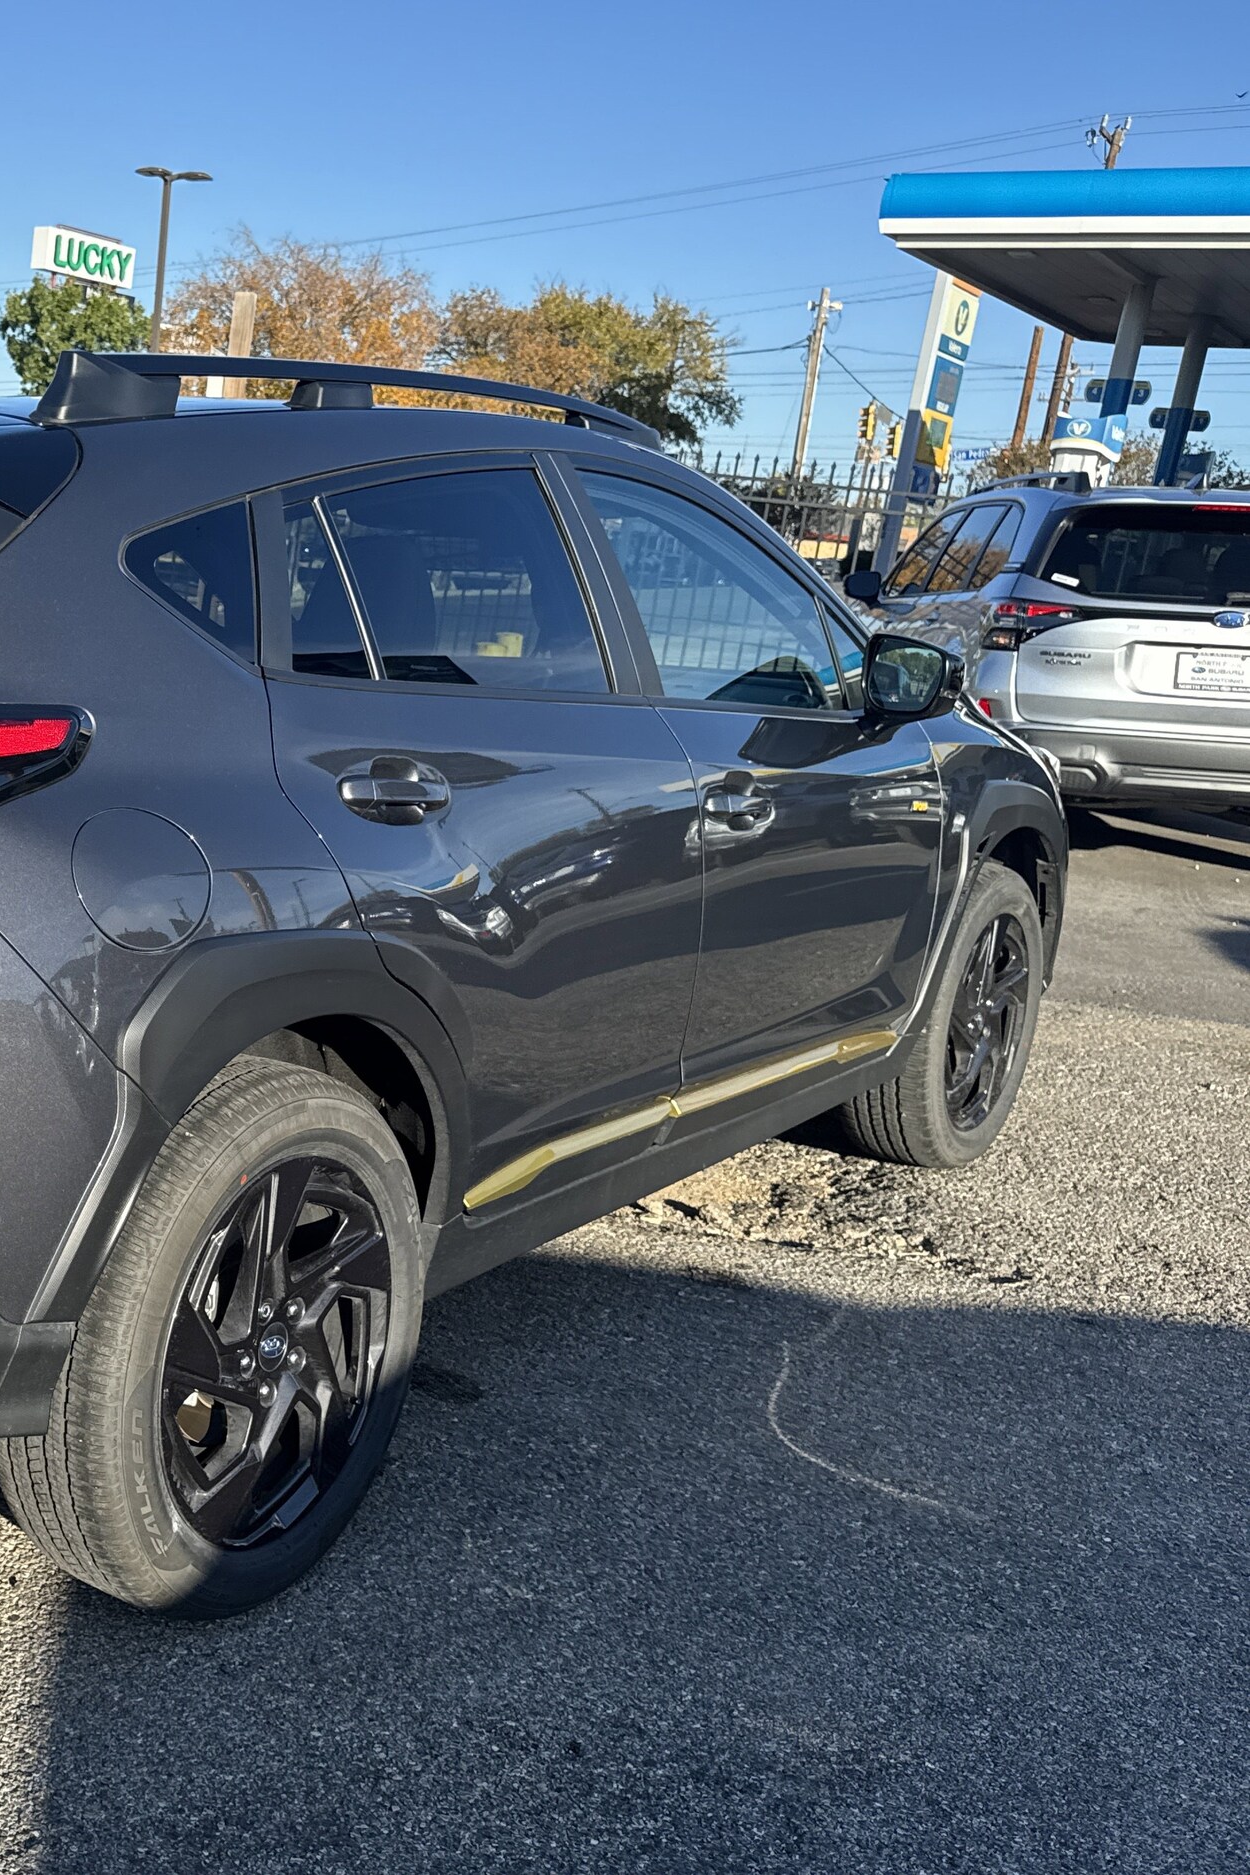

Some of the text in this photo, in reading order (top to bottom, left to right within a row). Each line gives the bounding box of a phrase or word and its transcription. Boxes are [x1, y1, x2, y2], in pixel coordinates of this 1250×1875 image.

[54, 235, 132, 282] LUCKY
[1091, 387, 1098, 396] 4
[1137, 389, 1144, 398] 3
[1039, 650, 1091, 659] SUBARU
[1208, 668, 1245, 676] SUBARU
